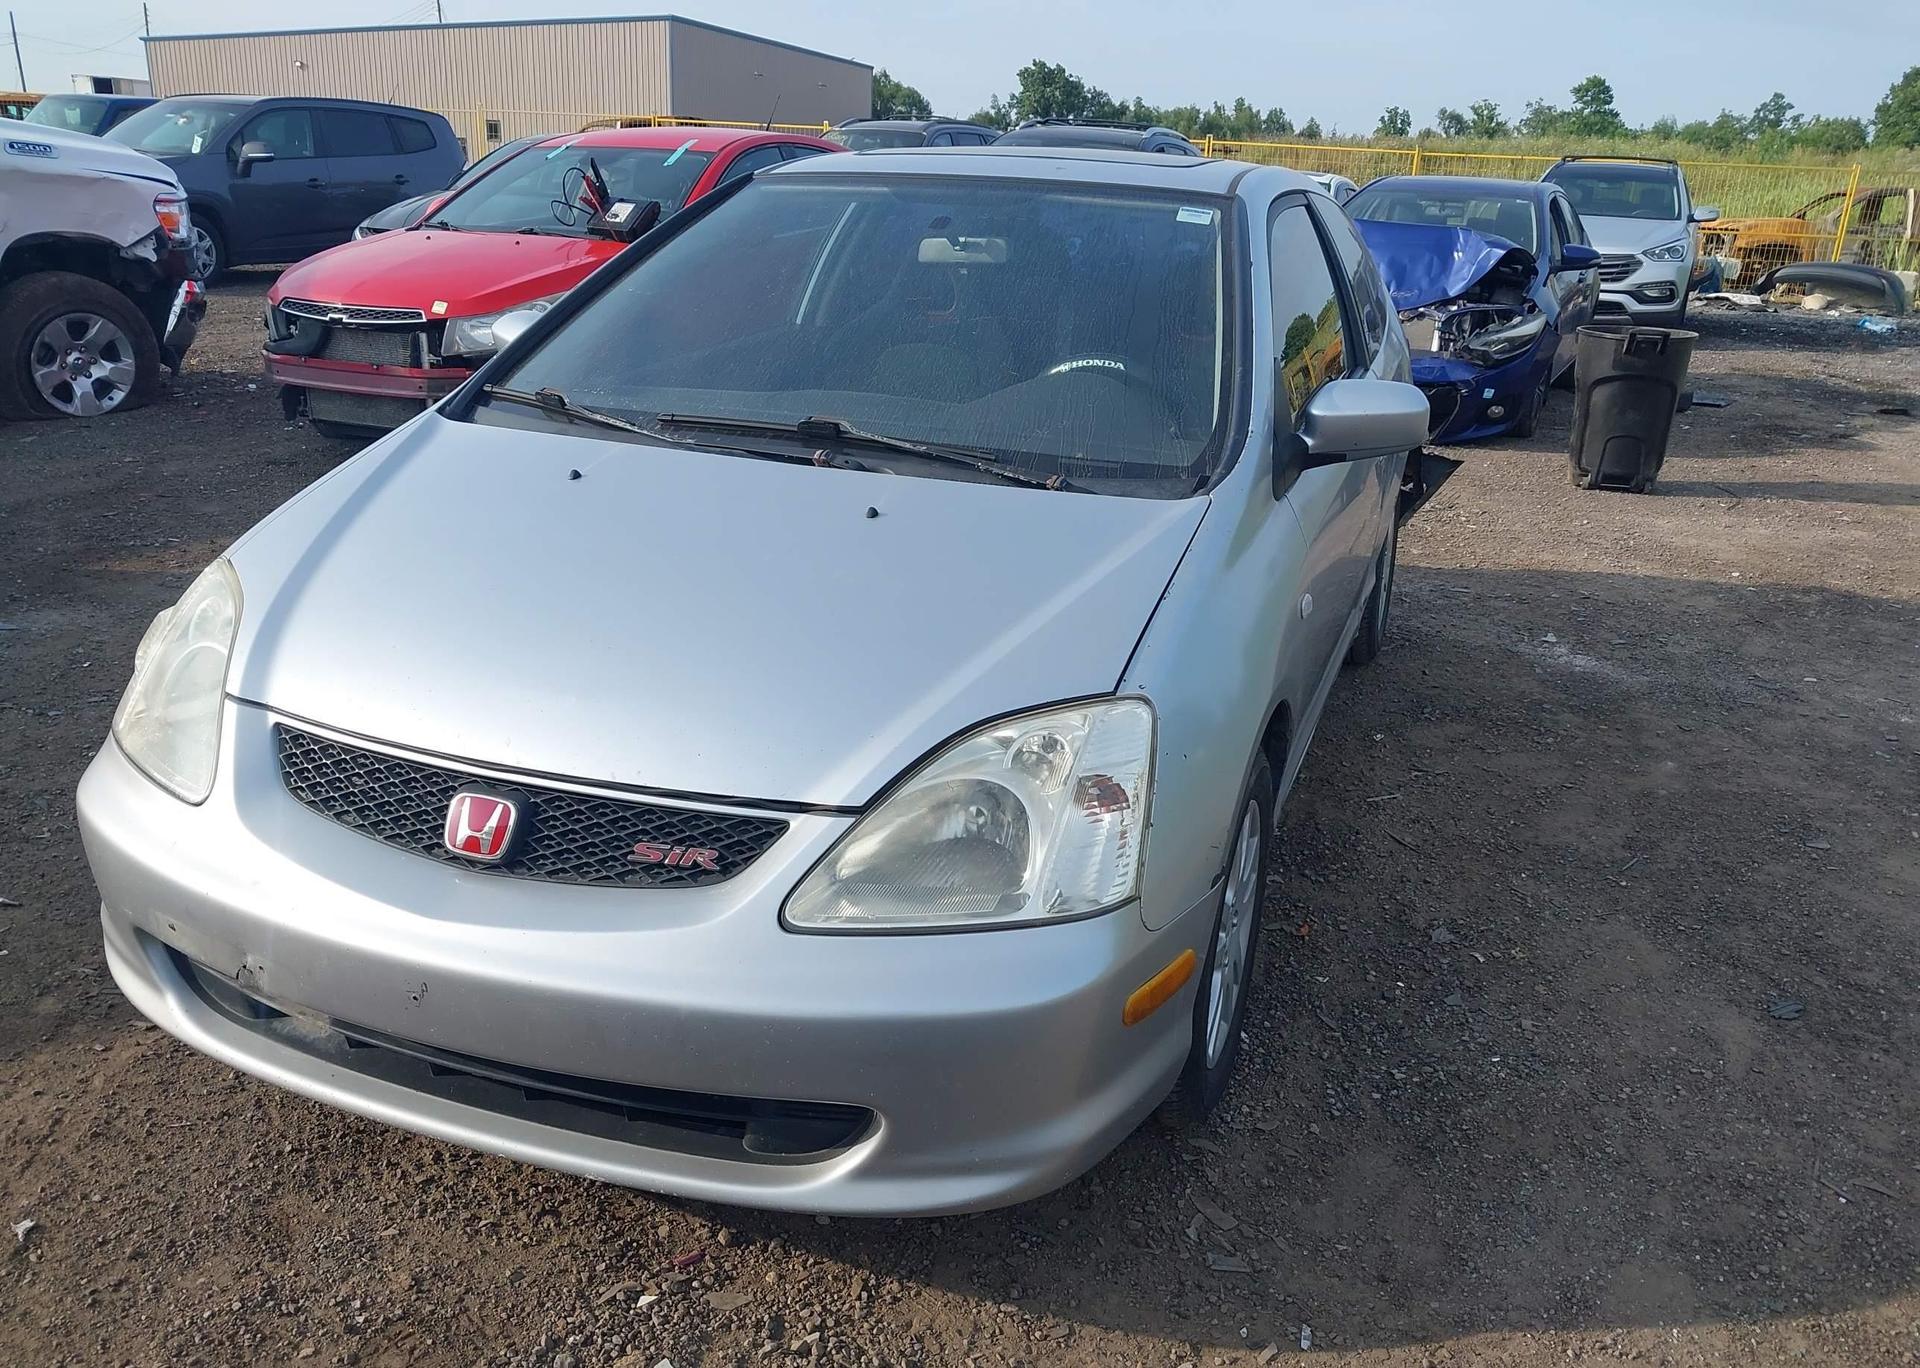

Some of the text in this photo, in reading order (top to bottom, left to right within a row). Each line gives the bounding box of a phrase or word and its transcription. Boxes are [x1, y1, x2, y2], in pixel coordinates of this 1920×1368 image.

[10, 142, 51, 152] 1500
[1071, 359, 1126, 371] HONDA
[627, 842, 720, 870] SiR
